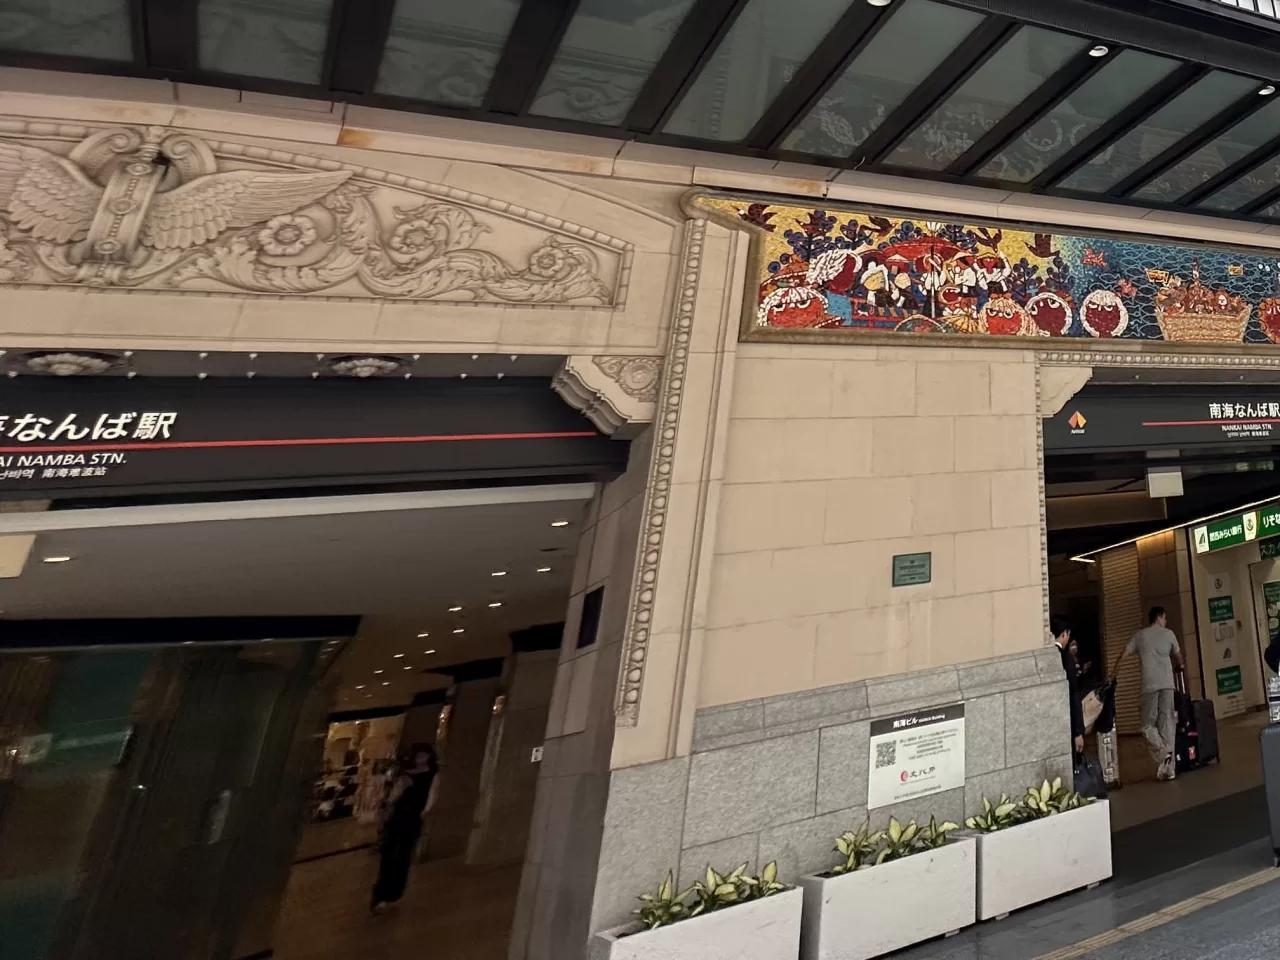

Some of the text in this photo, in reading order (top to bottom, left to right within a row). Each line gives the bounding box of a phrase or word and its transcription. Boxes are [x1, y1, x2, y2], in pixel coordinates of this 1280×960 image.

[1209, 402, 1280, 420] 南海なんば駅
[0, 411, 178, 442] なんば駅
[17, 453, 85, 467] NAMBA
[89, 452, 127, 465] STN.
